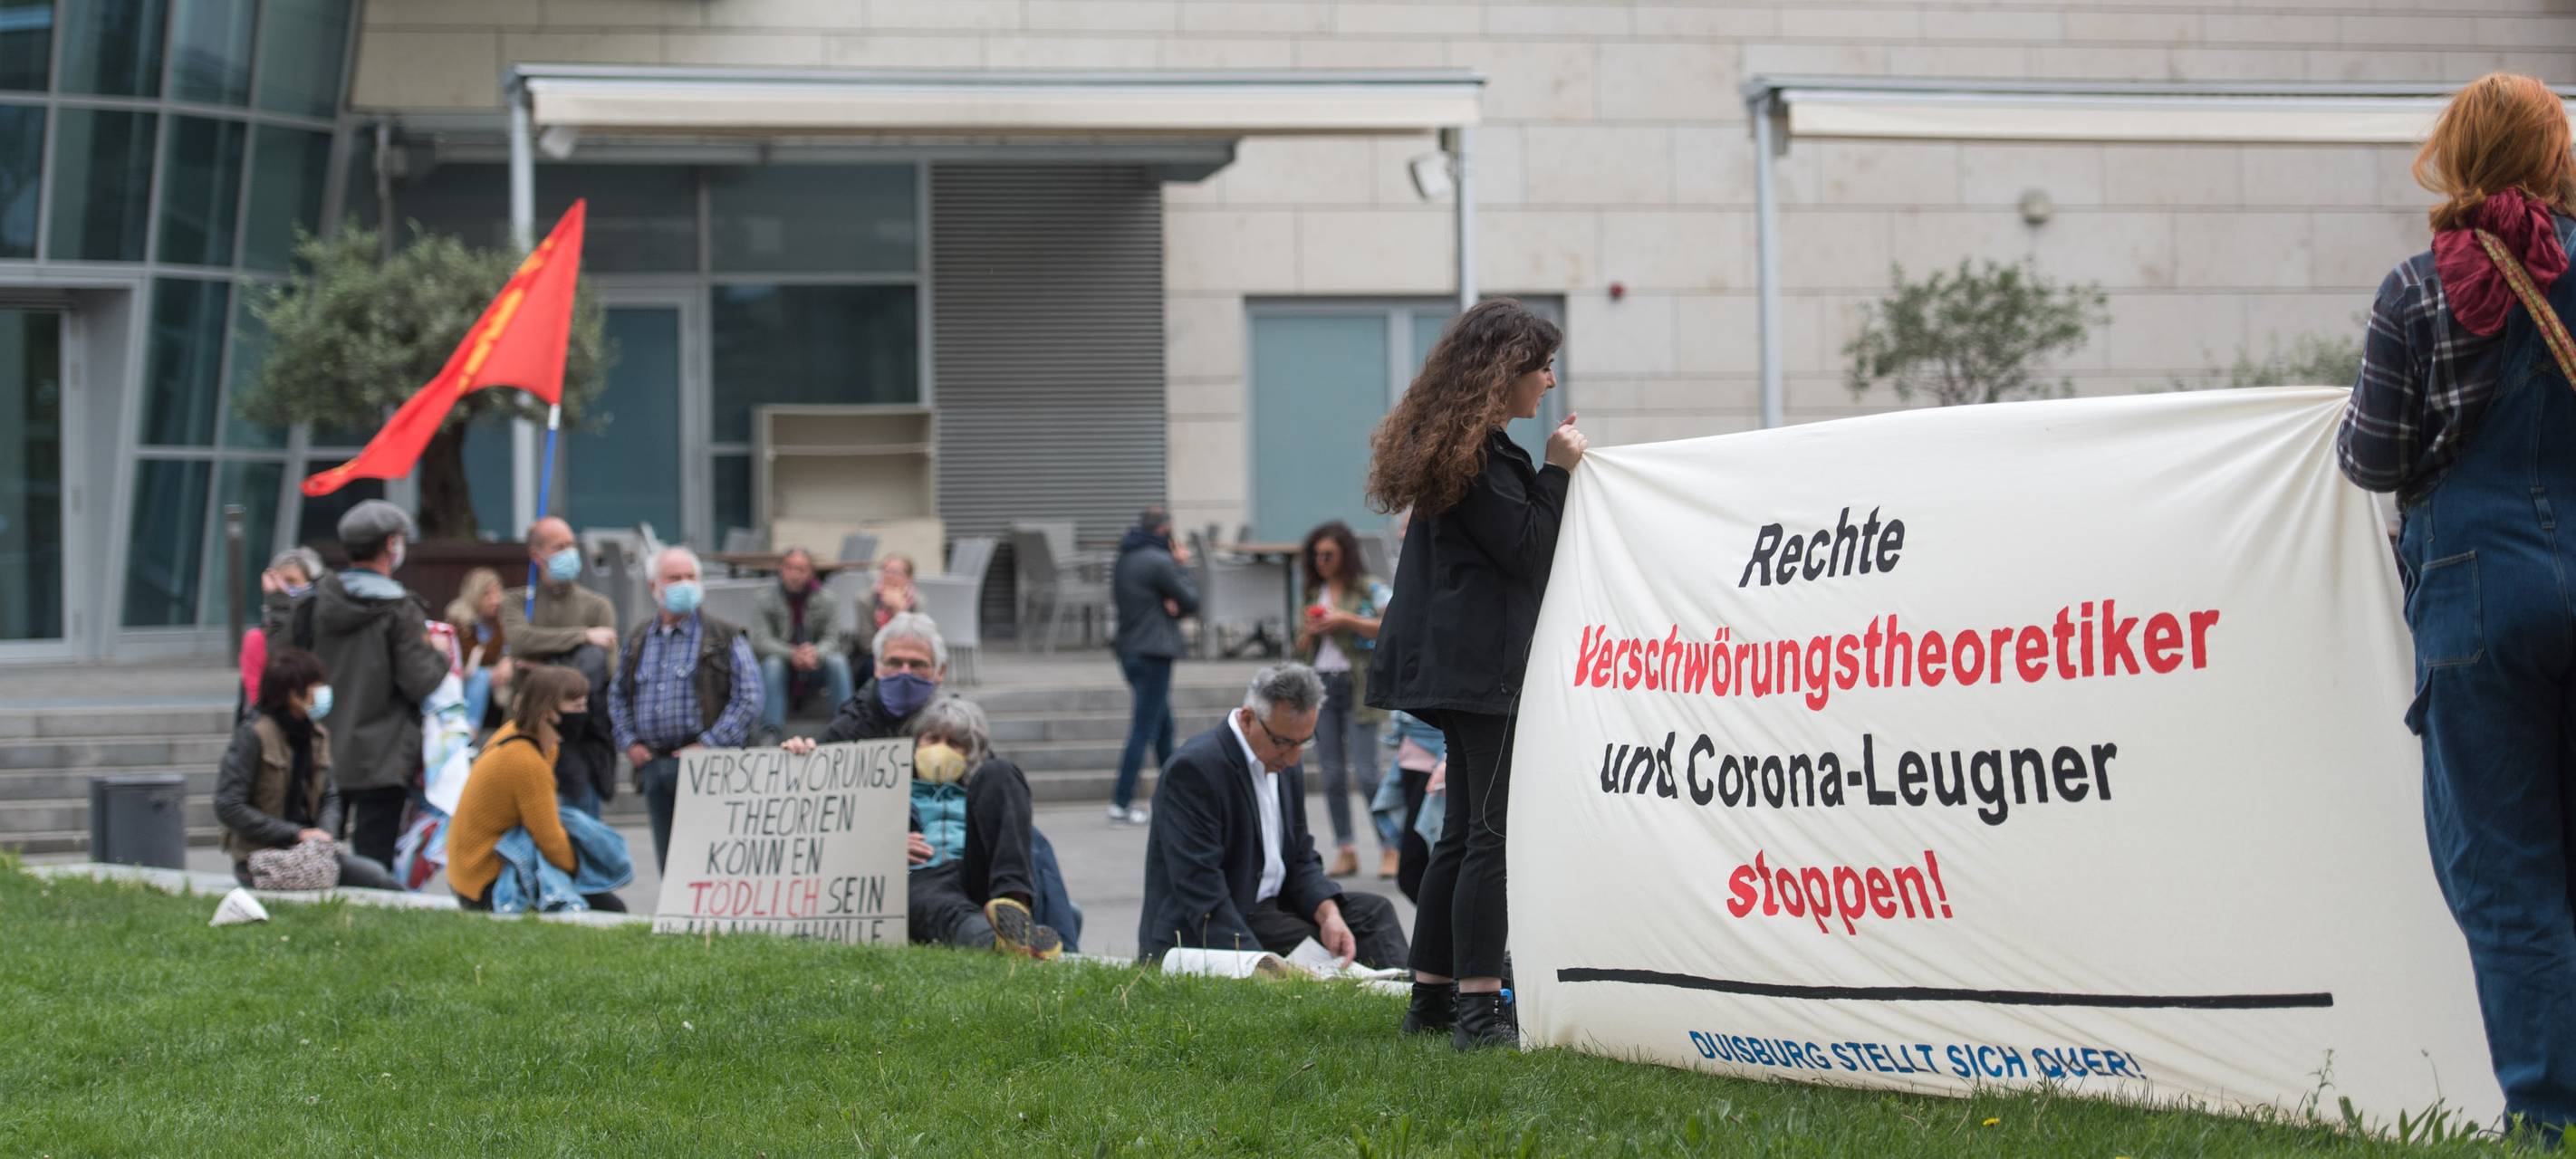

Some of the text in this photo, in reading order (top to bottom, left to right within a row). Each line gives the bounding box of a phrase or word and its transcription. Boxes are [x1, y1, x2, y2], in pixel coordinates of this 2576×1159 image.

[1738, 506, 1905, 588] Rechte
[1573, 599, 2220, 712] Verschwörungstheoretiker
[687, 745, 910, 795] VERSCHWÖRUNGS-
[1600, 731, 2118, 826] und Corona-Leugner
[725, 794, 856, 837] THEORIEN
[706, 837, 825, 876] KÖNNEN
[687, 876, 886, 916] TÖDLICH SEIN
[1726, 849, 1953, 935] stoppen!
[1688, 1030, 2148, 1080] DUISBURG STELLT SICH QUER!
